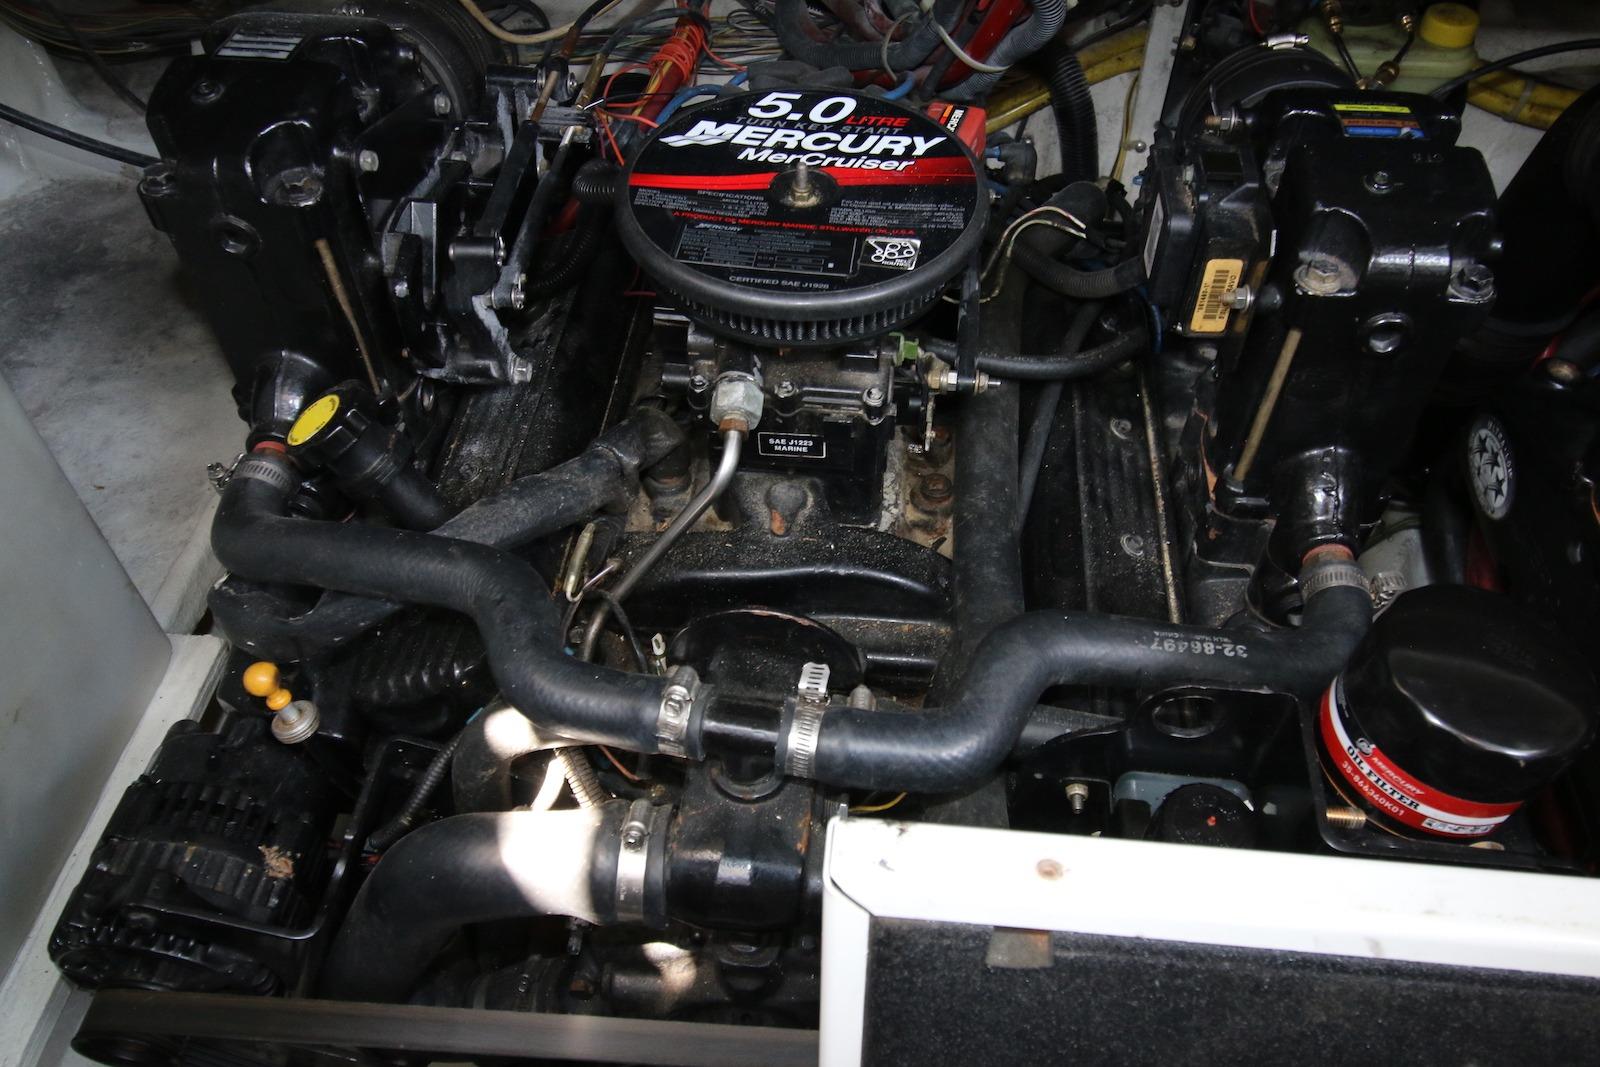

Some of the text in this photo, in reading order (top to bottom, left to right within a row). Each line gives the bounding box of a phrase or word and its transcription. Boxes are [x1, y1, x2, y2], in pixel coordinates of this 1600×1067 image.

[748, 91, 911, 127] 5.0 LITRE
[736, 116, 903, 135] TURN KEY START
[659, 120, 948, 157] MERCURY
[737, 147, 915, 171] MerCruiser
[697, 190, 765, 201] SPECIFICATIONS
[682, 212, 723, 221] PRODUCT
[739, 219, 780, 227] MERCURY
[695, 223, 743, 232] MERCURY
[729, 275, 779, 285] CERTIFIED
[774, 445, 808, 453] MARINE
[1347, 745, 1364, 770] OIL
[1367, 769, 1420, 810] FILTER
[1372, 757, 1424, 795] MERCURY
